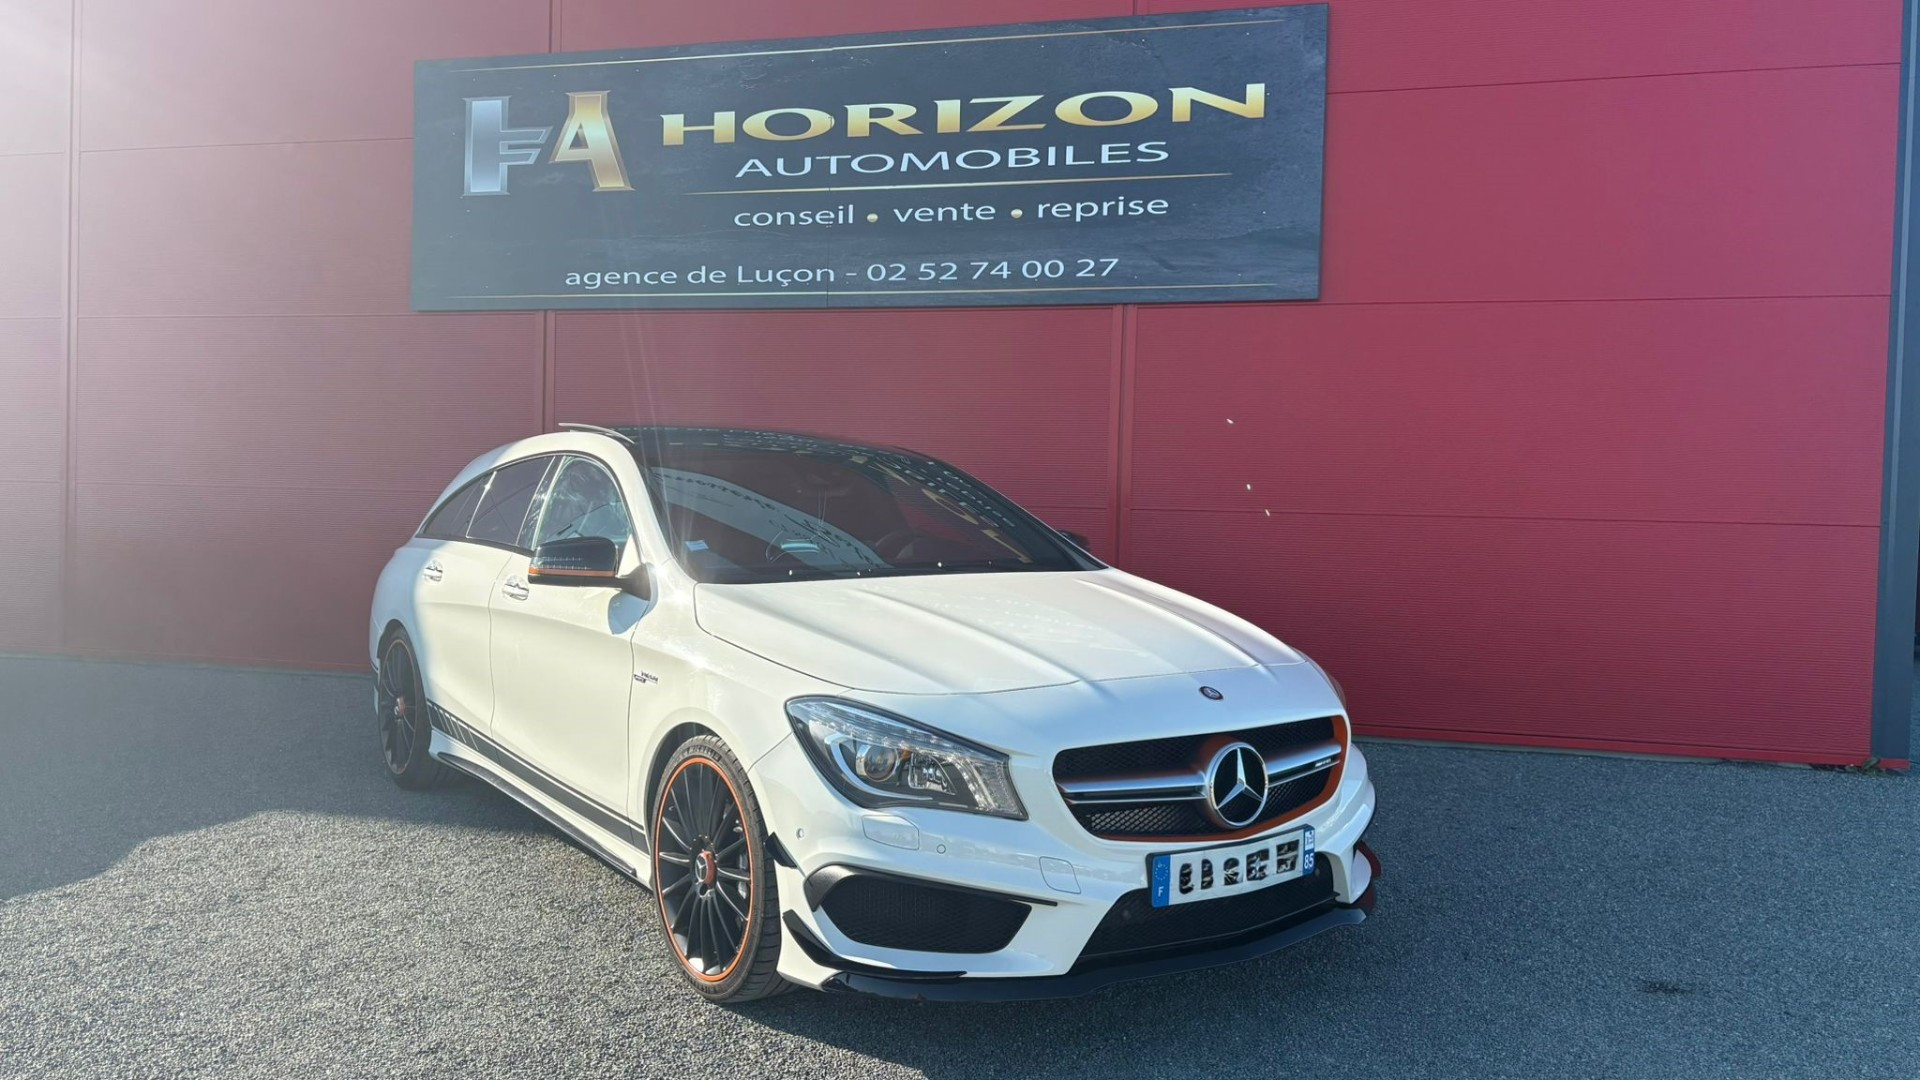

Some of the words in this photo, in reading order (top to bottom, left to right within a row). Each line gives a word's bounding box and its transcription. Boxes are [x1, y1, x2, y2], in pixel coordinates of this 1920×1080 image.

[660, 83, 1266, 147] HORIZON
[735, 141, 1170, 179] AUTOMOBILES
[734, 204, 854, 227] conseil
[893, 202, 996, 222] vente
[1037, 196, 1169, 223] reprise
[565, 269, 678, 290] agence
[687, 266, 727, 284] de
[737, 265, 835, 288] Luçon
[867, 263, 907, 282] 02
[917, 262, 958, 281] 52
[970, 261, 1012, 280] 74
[1022, 259, 1065, 279] 00
[1076, 257, 1120, 278] 27
[1304, 852, 1315, 870] 85
[1157, 886, 1165, 897] F
